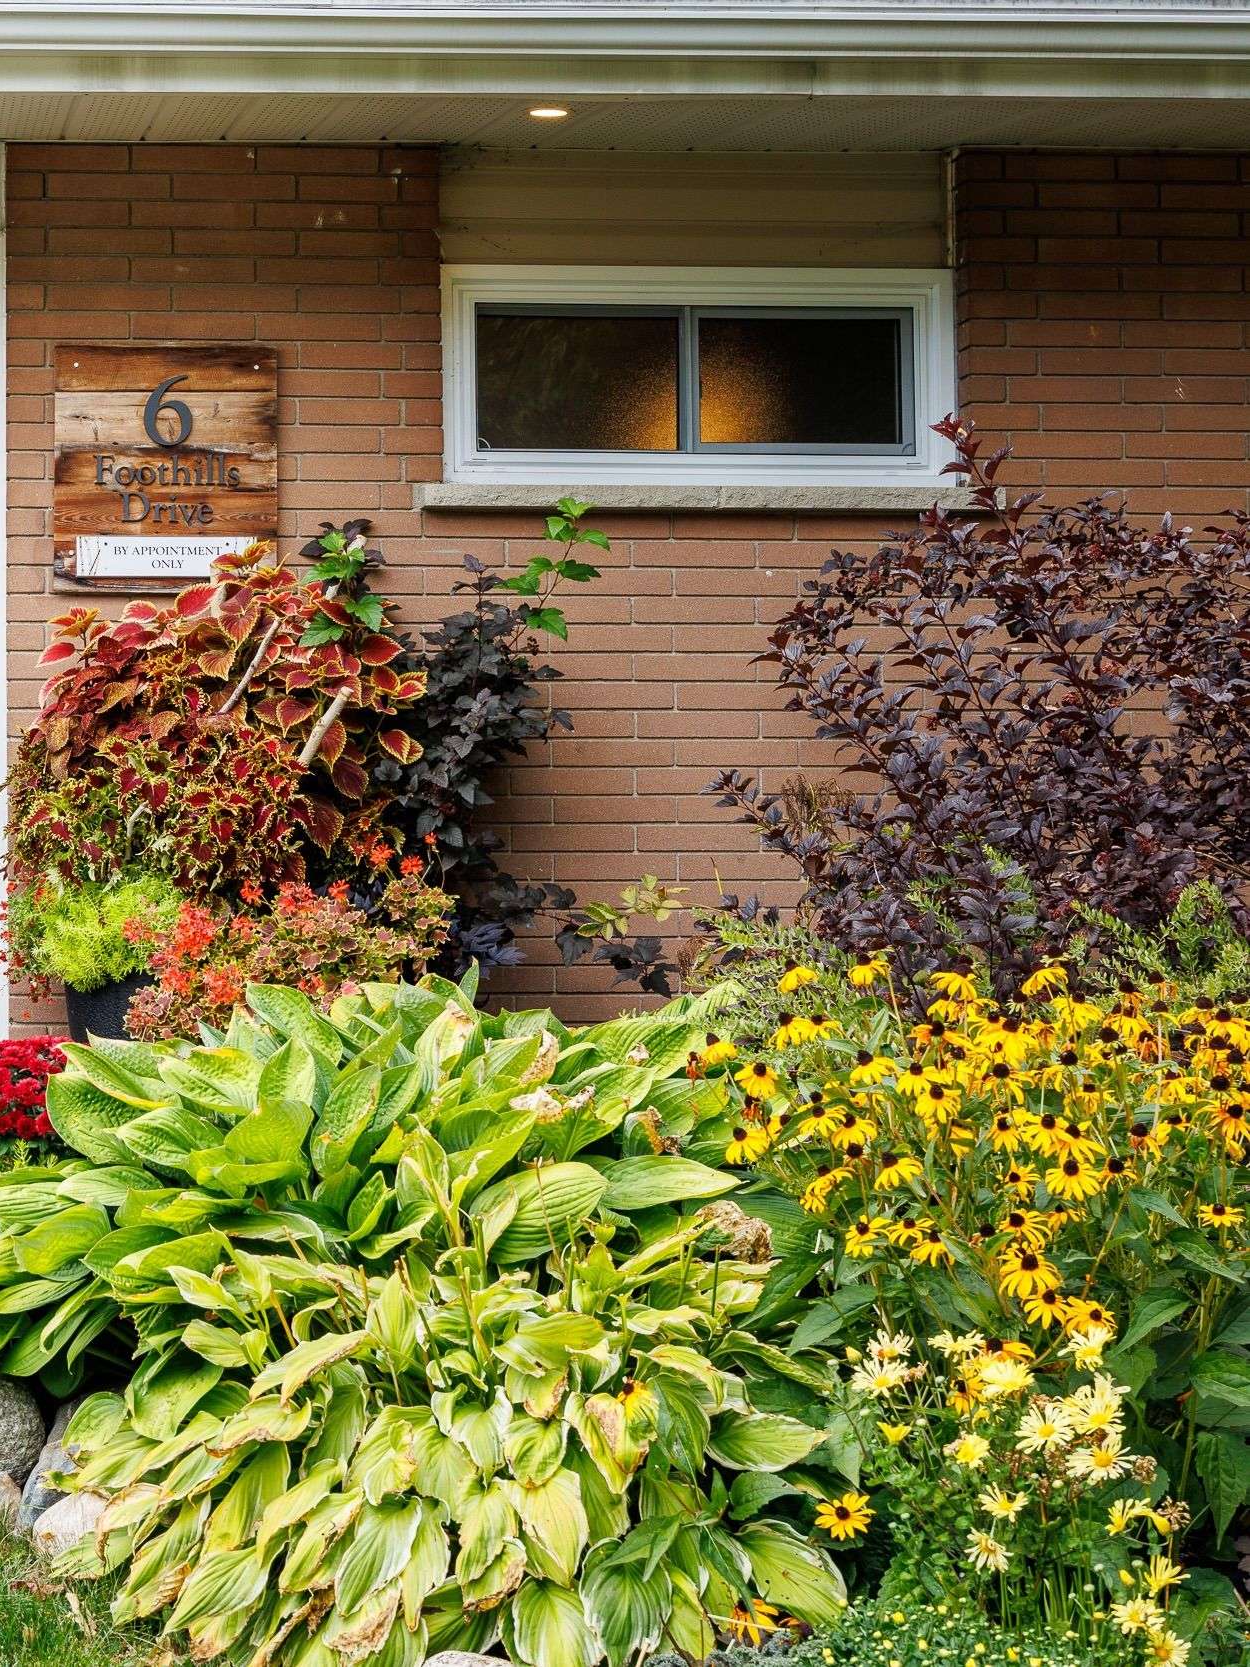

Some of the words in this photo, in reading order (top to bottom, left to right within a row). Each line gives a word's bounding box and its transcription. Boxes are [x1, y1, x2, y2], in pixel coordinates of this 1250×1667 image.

[144, 374, 193, 446] 6
[94, 452, 241, 487] Foothills
[121, 492, 213, 526] Drive
[113, 546, 128, 556] BY
[132, 546, 223, 556] APPOINTMENT
[151, 559, 184, 569] ONLY
